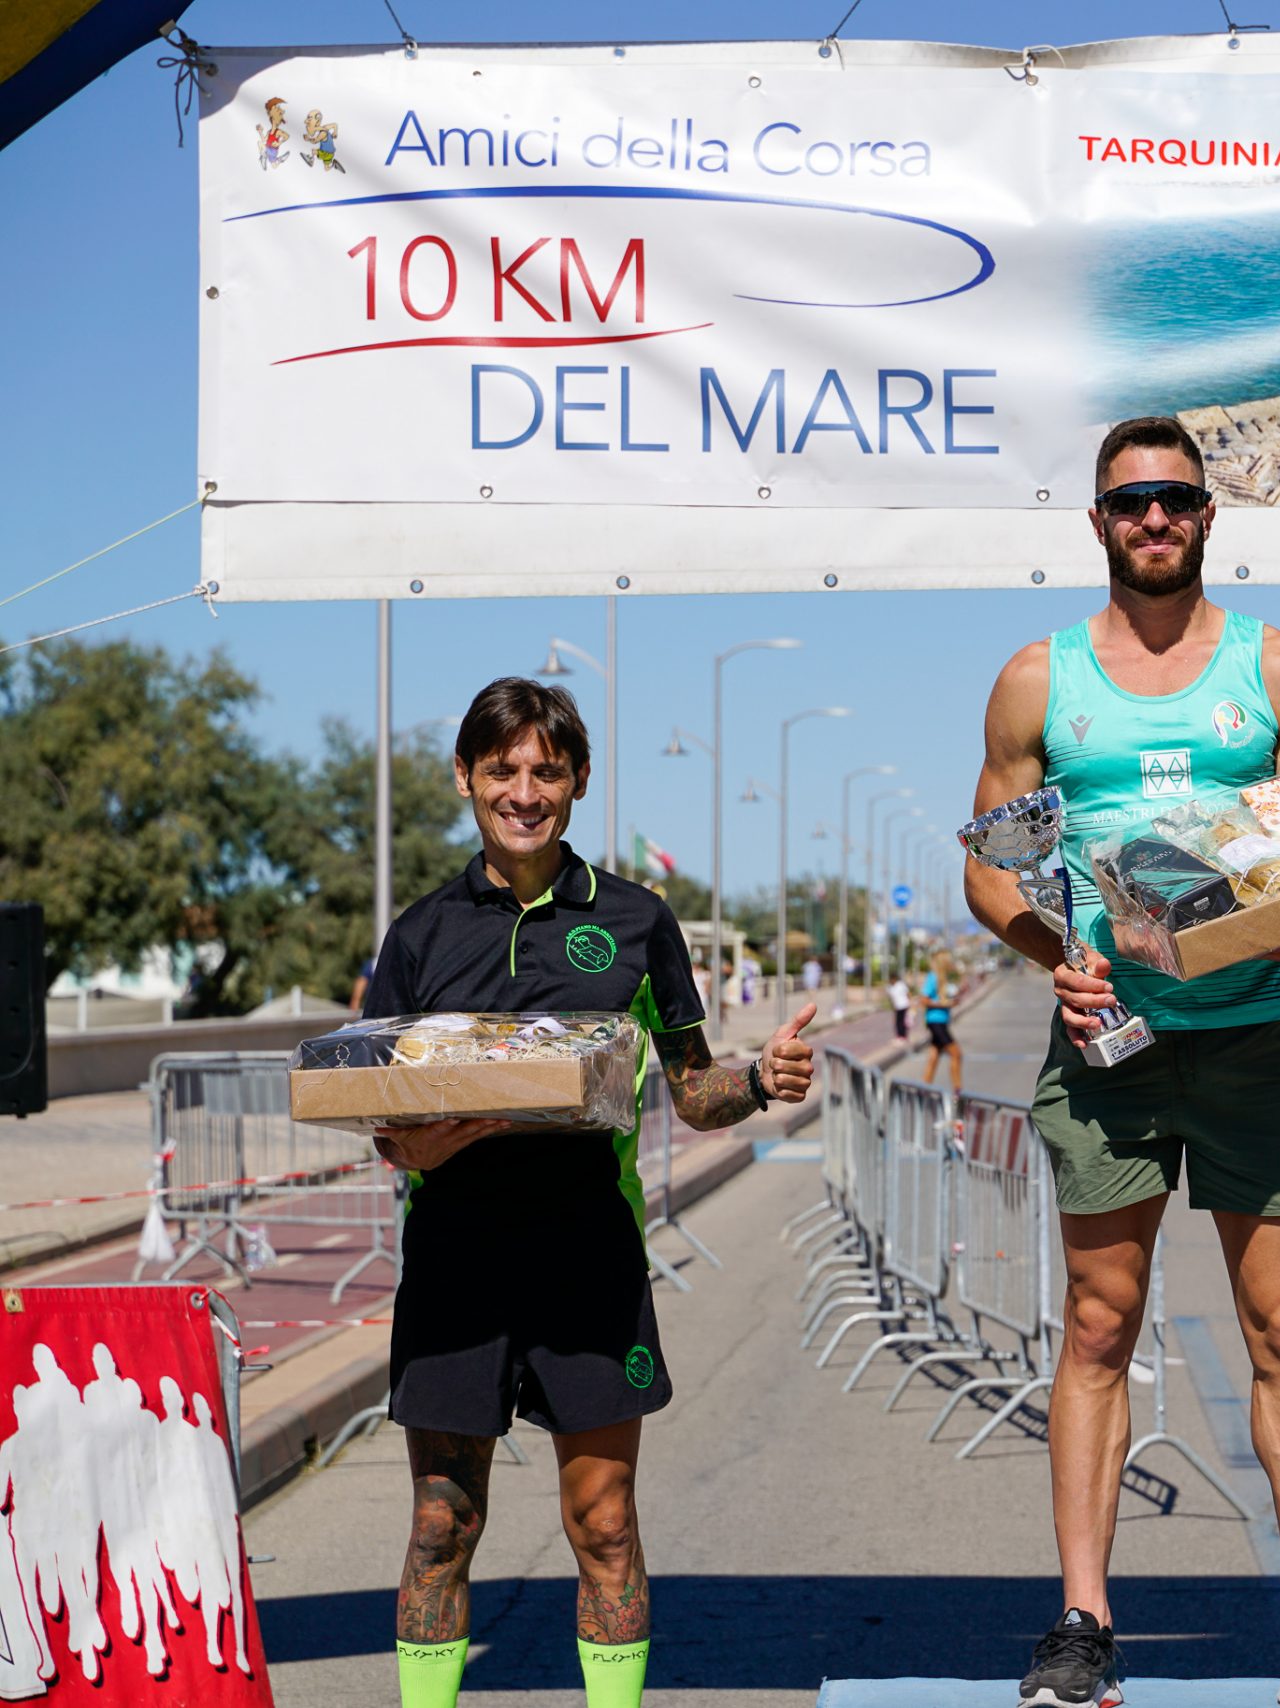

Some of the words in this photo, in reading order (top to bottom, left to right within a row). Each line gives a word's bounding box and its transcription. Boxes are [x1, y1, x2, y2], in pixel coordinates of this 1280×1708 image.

[384, 111, 558, 168] Amici
[586, 117, 729, 173] della
[753, 121, 932, 177] Corsa
[348, 234, 458, 322] 10
[490, 236, 645, 323] KM
[470, 363, 670, 452] DEL
[699, 367, 1001, 456] MARE
[1118, 1034, 1148, 1055] ASSOLUTO
